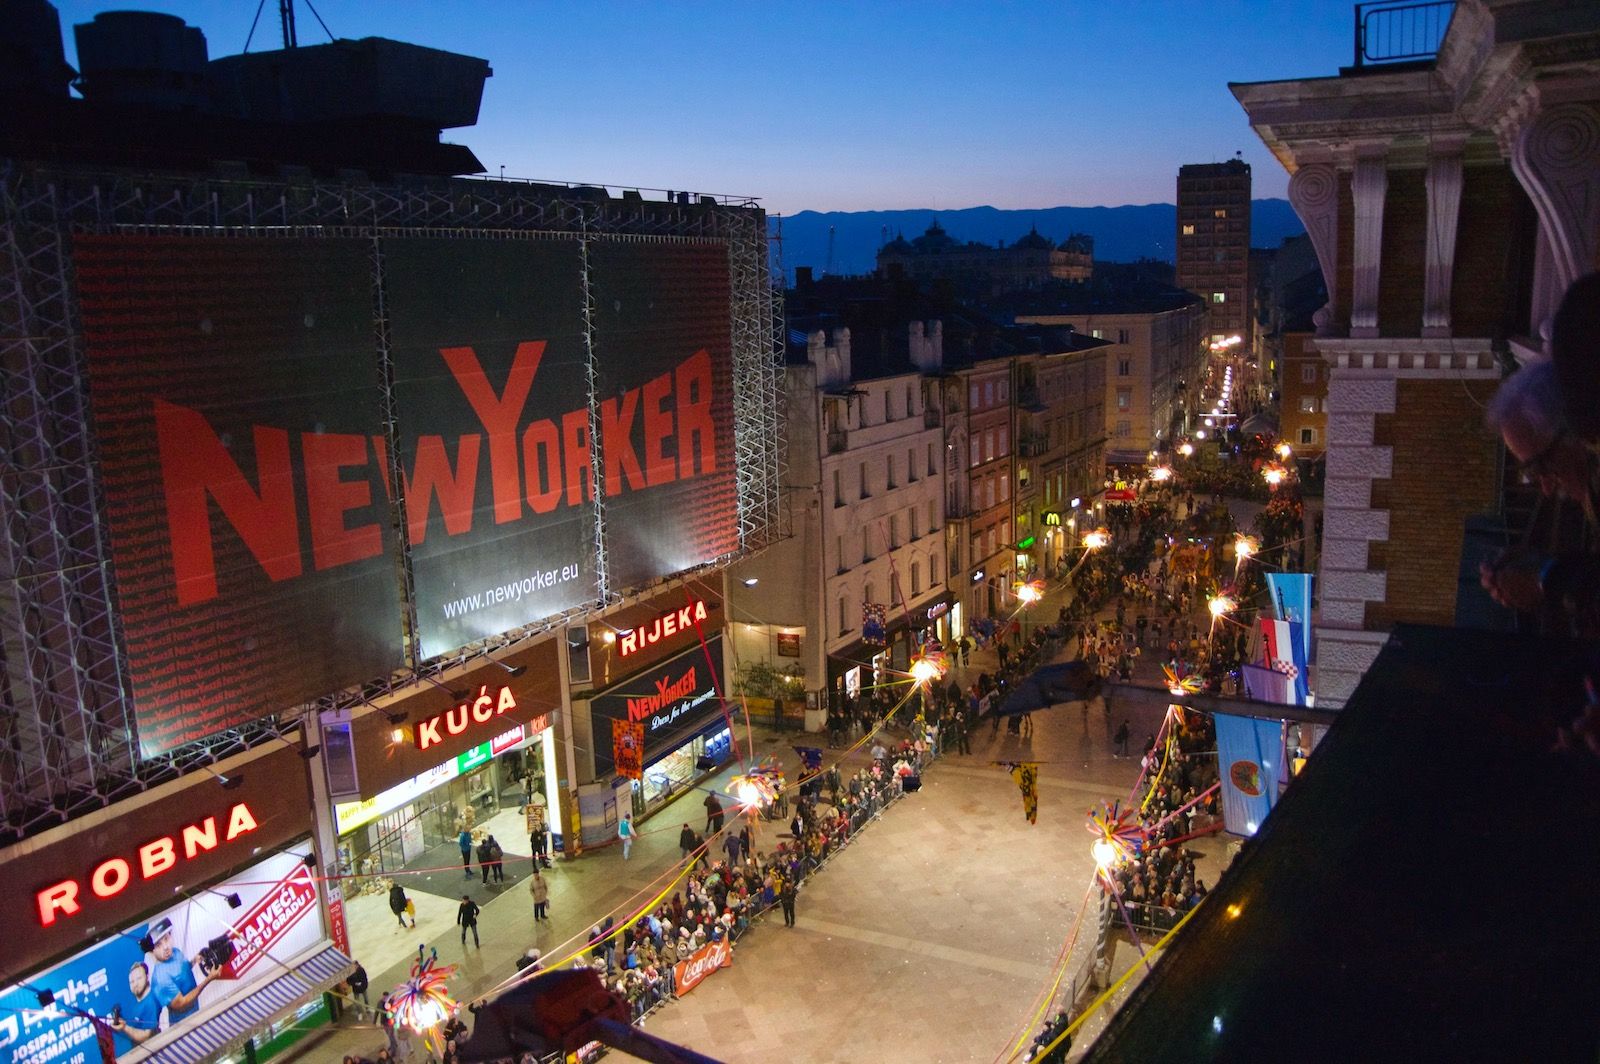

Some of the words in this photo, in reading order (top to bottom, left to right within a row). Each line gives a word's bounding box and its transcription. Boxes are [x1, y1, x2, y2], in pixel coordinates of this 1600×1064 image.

[443, 563, 579, 619] www.newyorker.eu
[621, 600, 708, 657] RIJEKA
[418, 685, 517, 750] KUĆA
[37, 802, 258, 928] ROBNA
[231, 886, 297, 953] NAJVEĆI
[12, 1029, 58, 1064] JOSIPA
